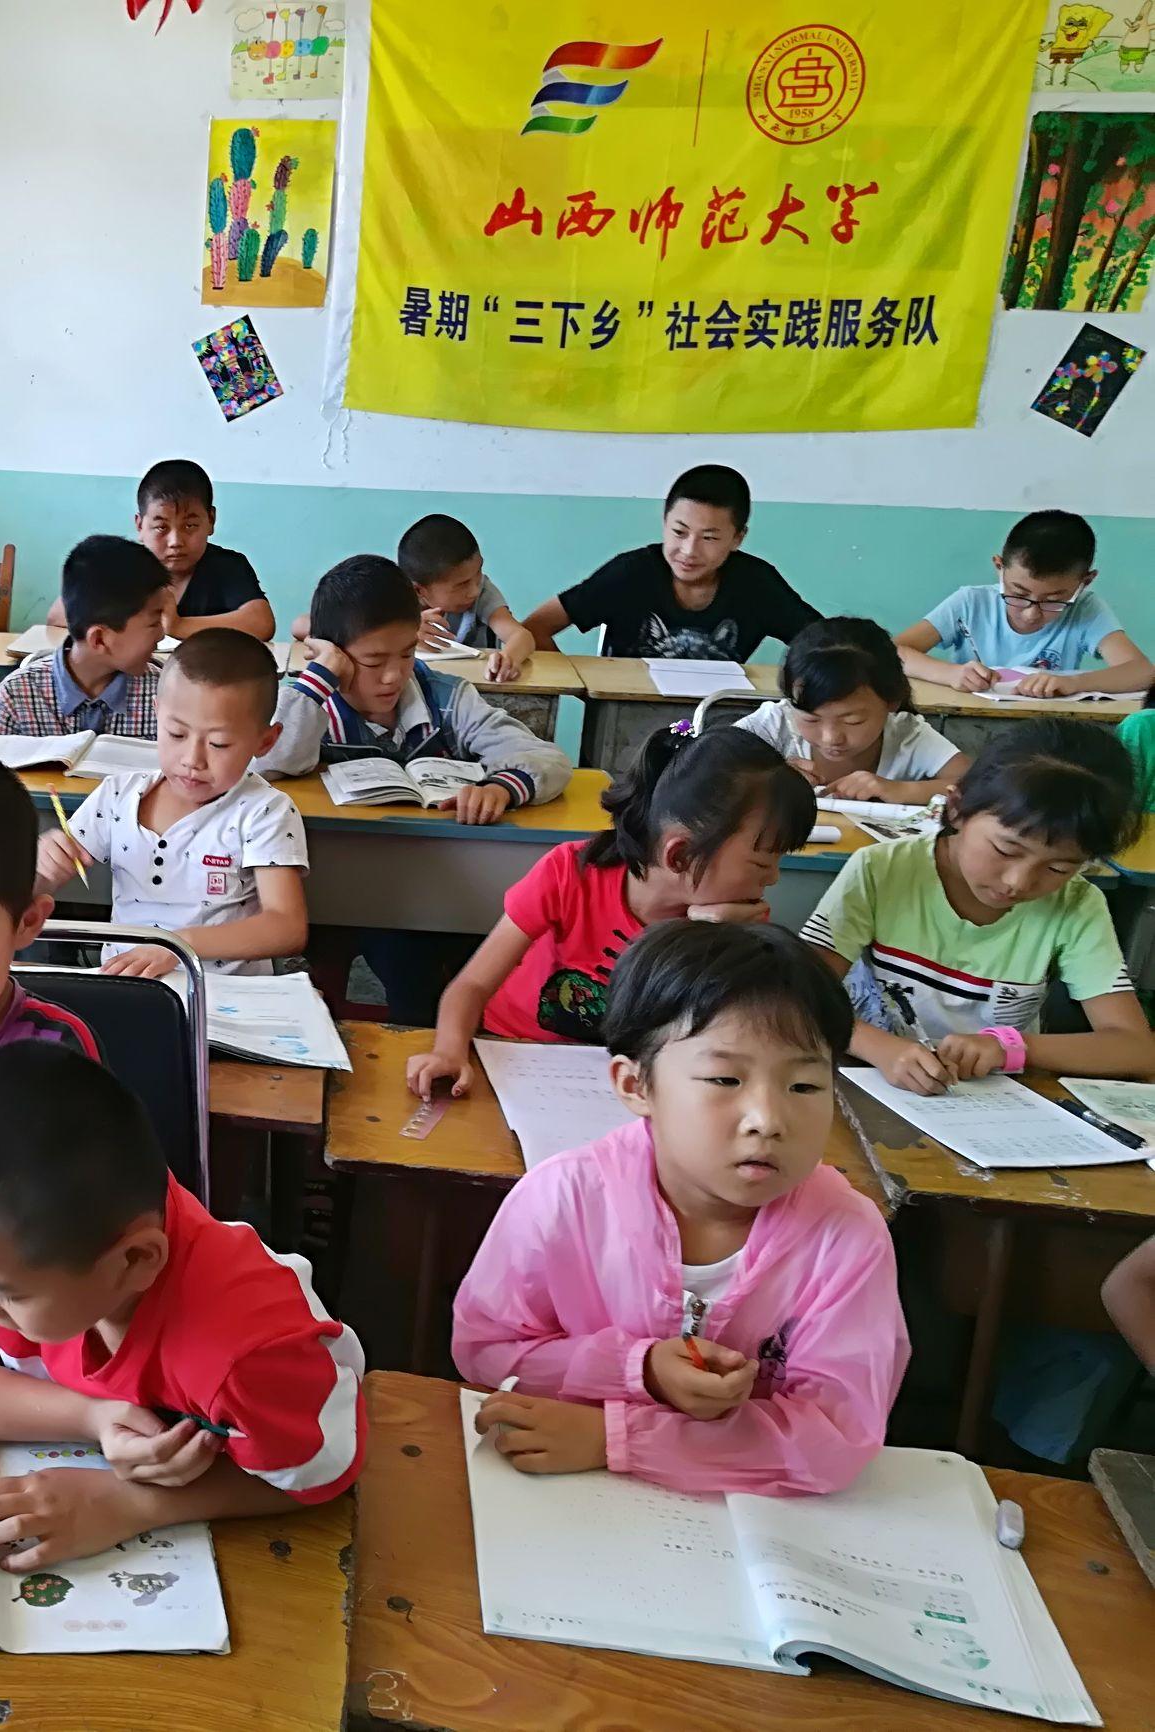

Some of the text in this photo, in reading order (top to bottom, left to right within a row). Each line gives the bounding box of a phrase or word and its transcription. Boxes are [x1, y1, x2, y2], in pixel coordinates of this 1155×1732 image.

[774, 31, 823, 52] NORMAL
[789, 107, 814, 119] 1958
[483, 181, 879, 263] 山西师范大学
[399, 285, 940, 352] 暑期“三下乡”社会实践服务队
